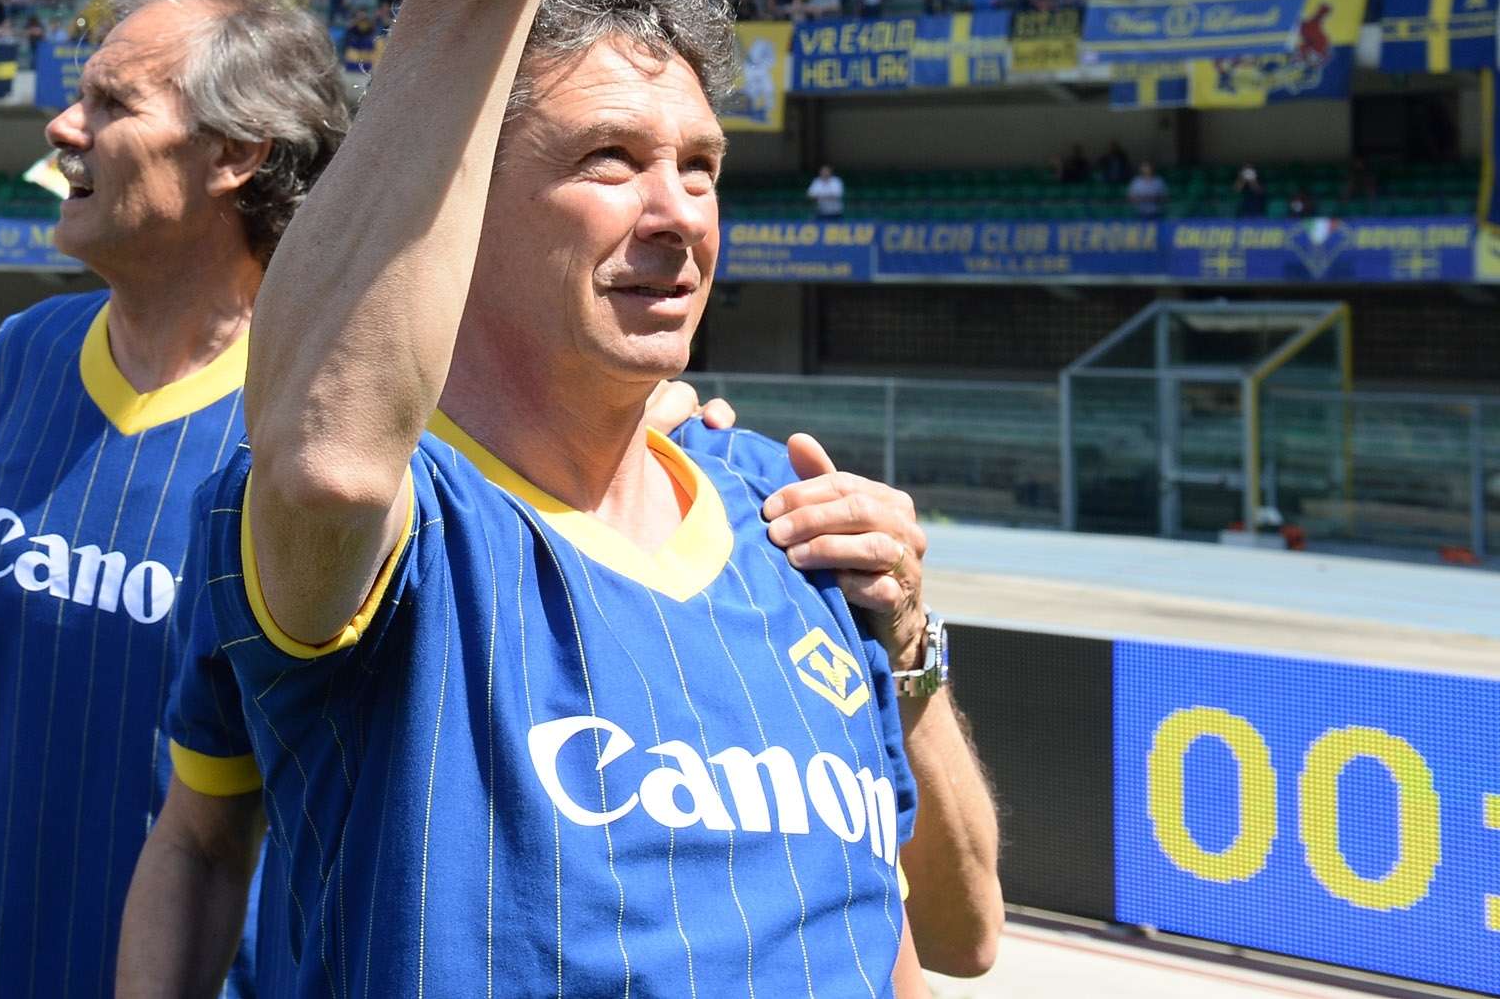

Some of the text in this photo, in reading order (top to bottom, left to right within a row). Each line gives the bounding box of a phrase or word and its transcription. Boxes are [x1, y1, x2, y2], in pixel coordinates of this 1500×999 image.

[729, 223, 875, 246] GIALLO BLU
[882, 222, 1158, 252] CALCIO CLUB VERONA
[528, 715, 897, 868] Canon
